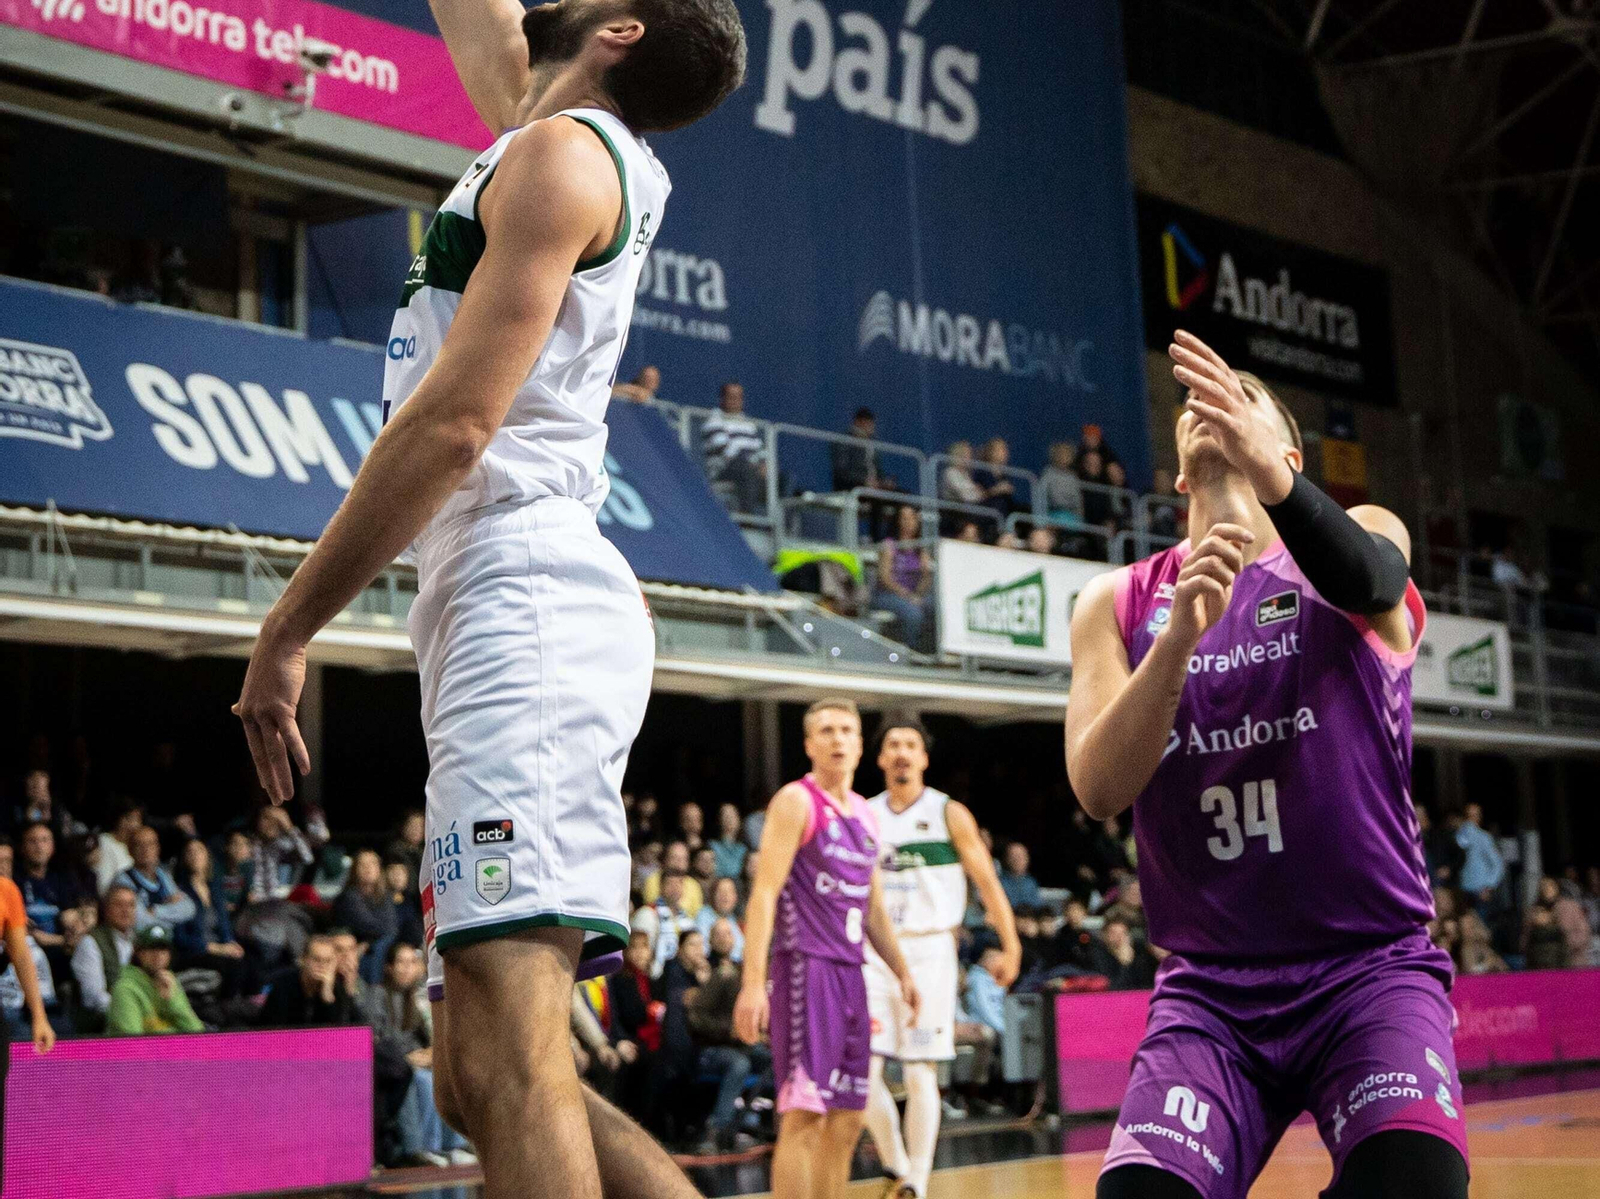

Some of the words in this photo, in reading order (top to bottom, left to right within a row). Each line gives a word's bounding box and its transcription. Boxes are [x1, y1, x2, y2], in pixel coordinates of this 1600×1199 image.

[252, 23, 400, 94] telcom
[1212, 252, 1361, 348] Andorra
[125, 362, 355, 490] SOM
[476, 828, 506, 842] acb
[1200, 779, 1284, 861] 34
[1348, 1072, 1418, 1102] andorra
[1348, 1086, 1423, 1116] telecom
[1125, 1121, 1185, 1144] Andorra
[1186, 1135, 1200, 1153] la
